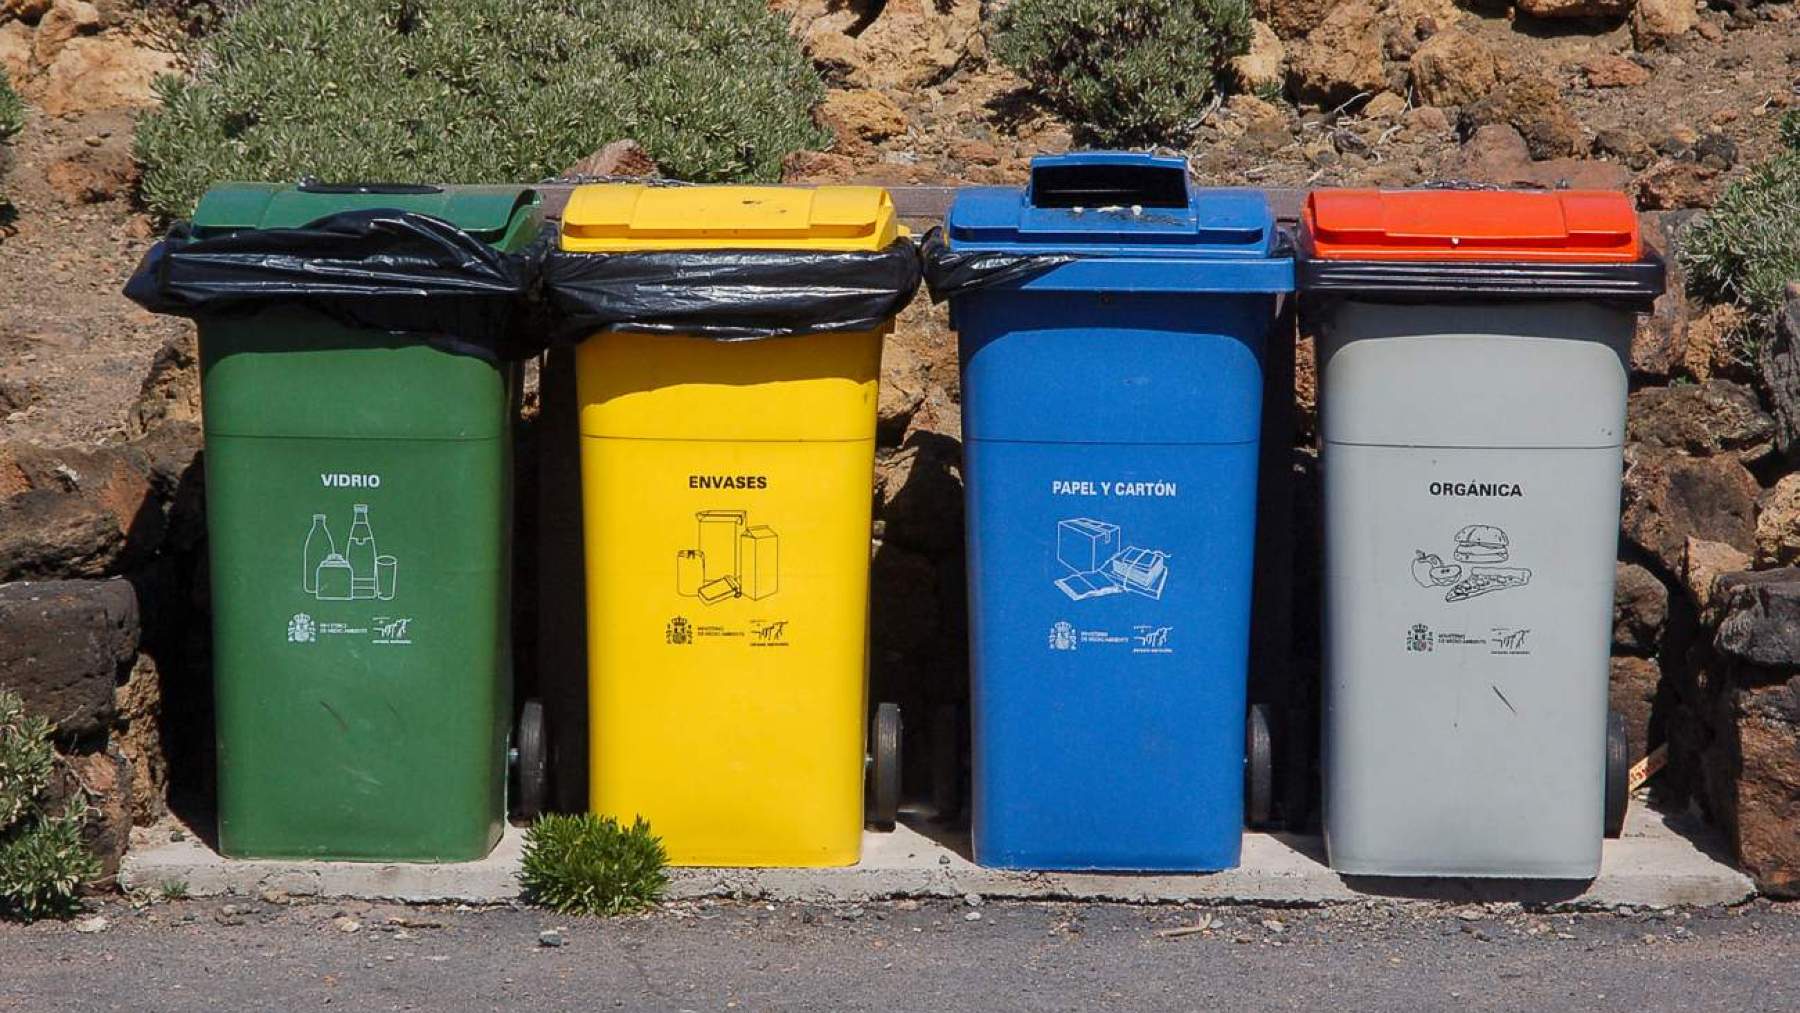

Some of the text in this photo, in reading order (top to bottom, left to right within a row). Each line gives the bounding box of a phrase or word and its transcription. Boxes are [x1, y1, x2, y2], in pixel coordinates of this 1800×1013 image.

[320, 473, 381, 488] VIDRIO
[688, 475, 768, 490] ENVASES
[1052, 479, 1177, 497] PAPEL Y CARTÓN
[1429, 479, 1523, 497] ORGÁNICA
